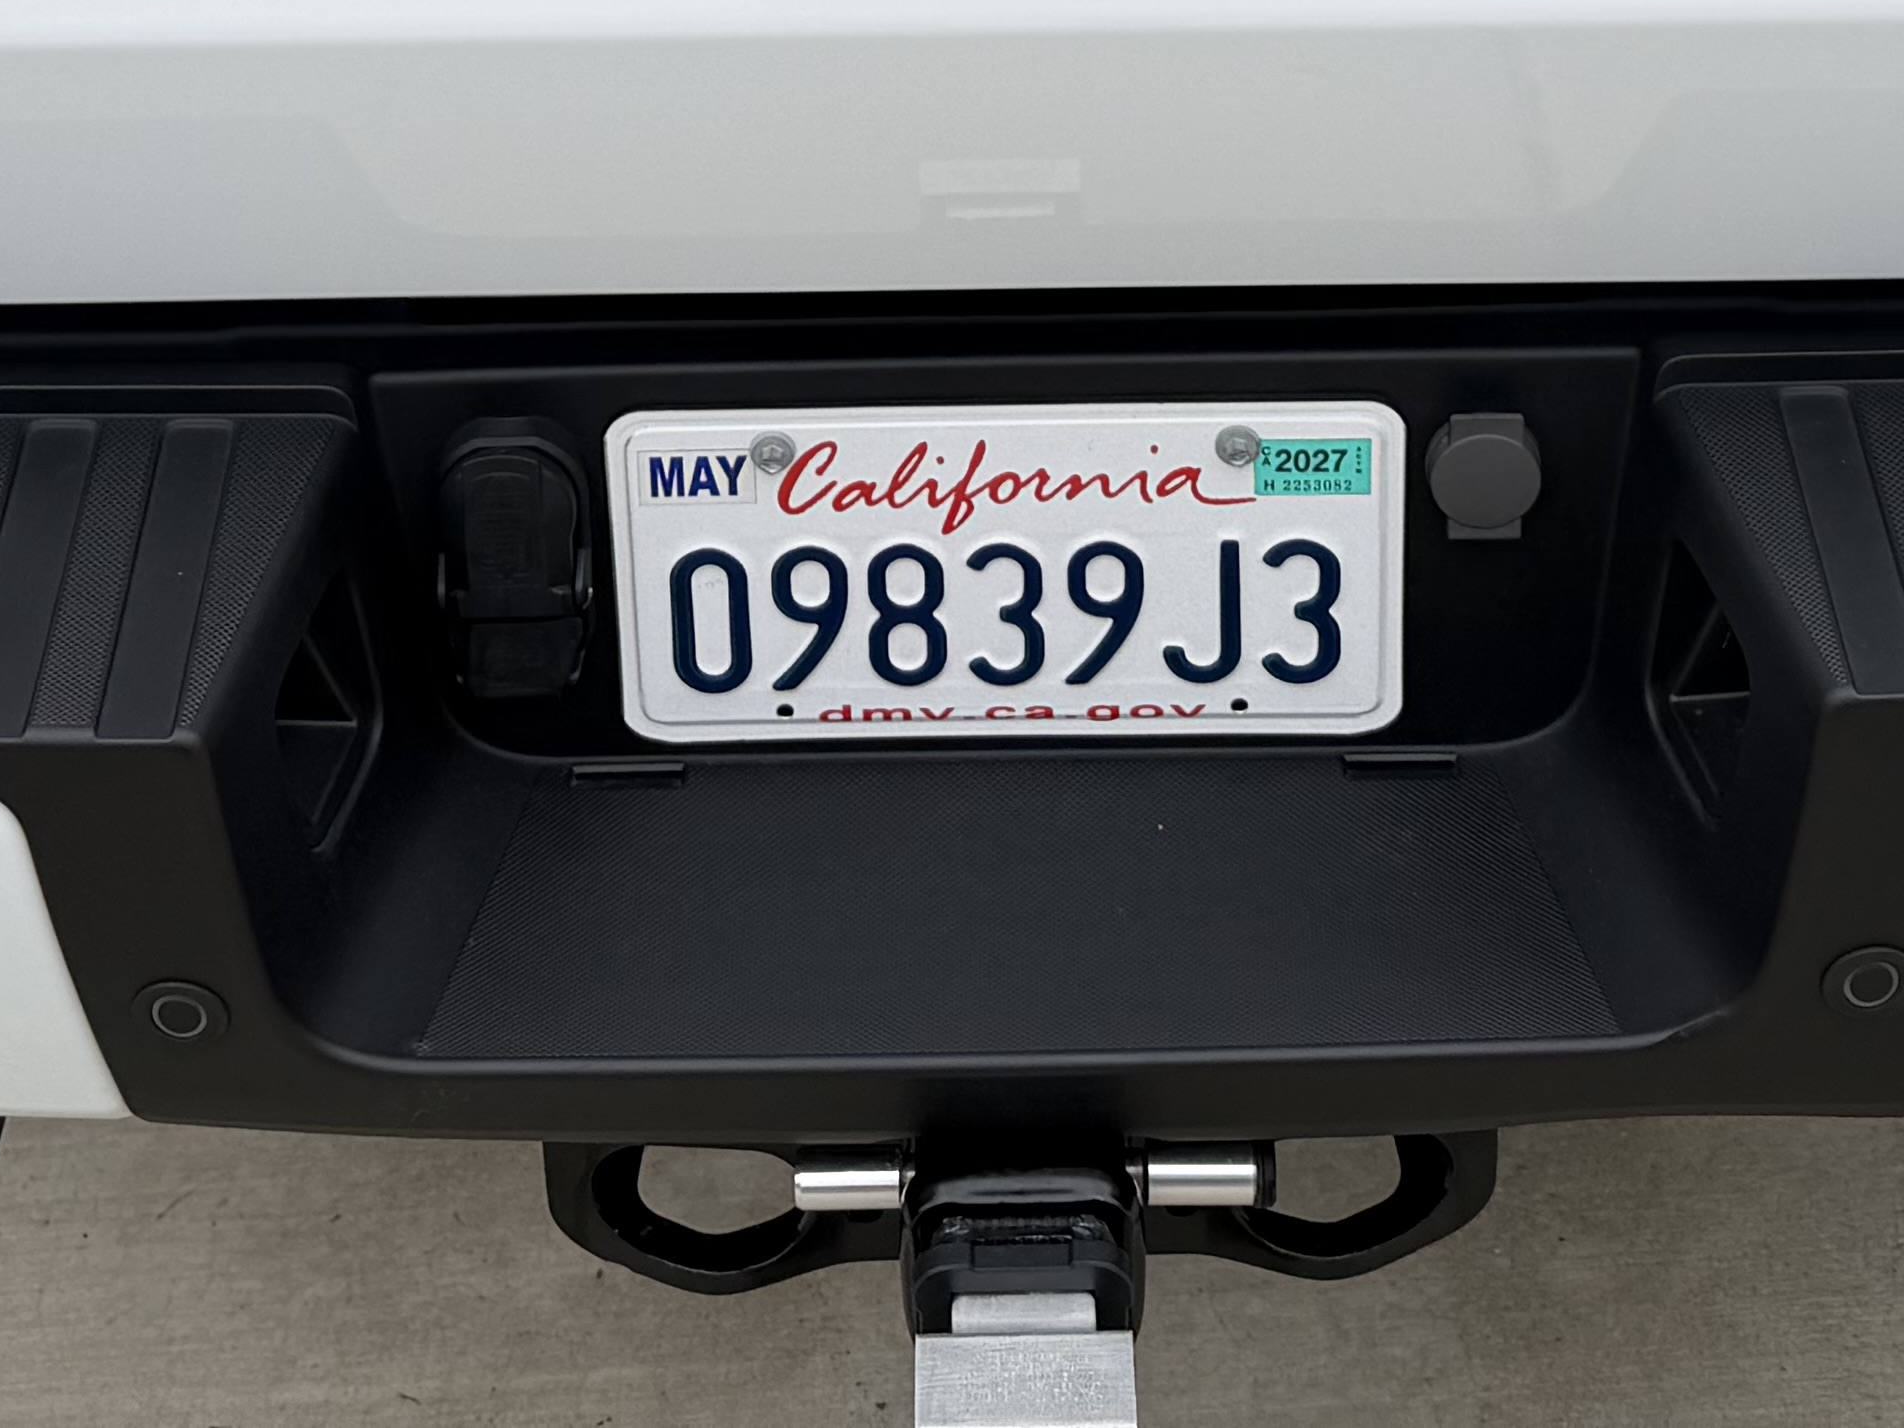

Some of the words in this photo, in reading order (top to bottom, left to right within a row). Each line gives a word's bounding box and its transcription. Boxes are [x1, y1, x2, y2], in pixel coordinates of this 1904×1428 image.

[1261, 446, 1271, 466] CA
[1274, 448, 1348, 473] 2027
[649, 455, 747, 497] MAY
[777, 439, 1257, 535] California
[669, 538, 1343, 694] 09839J3
[818, 704, 1207, 722] dmv.ca.gov
